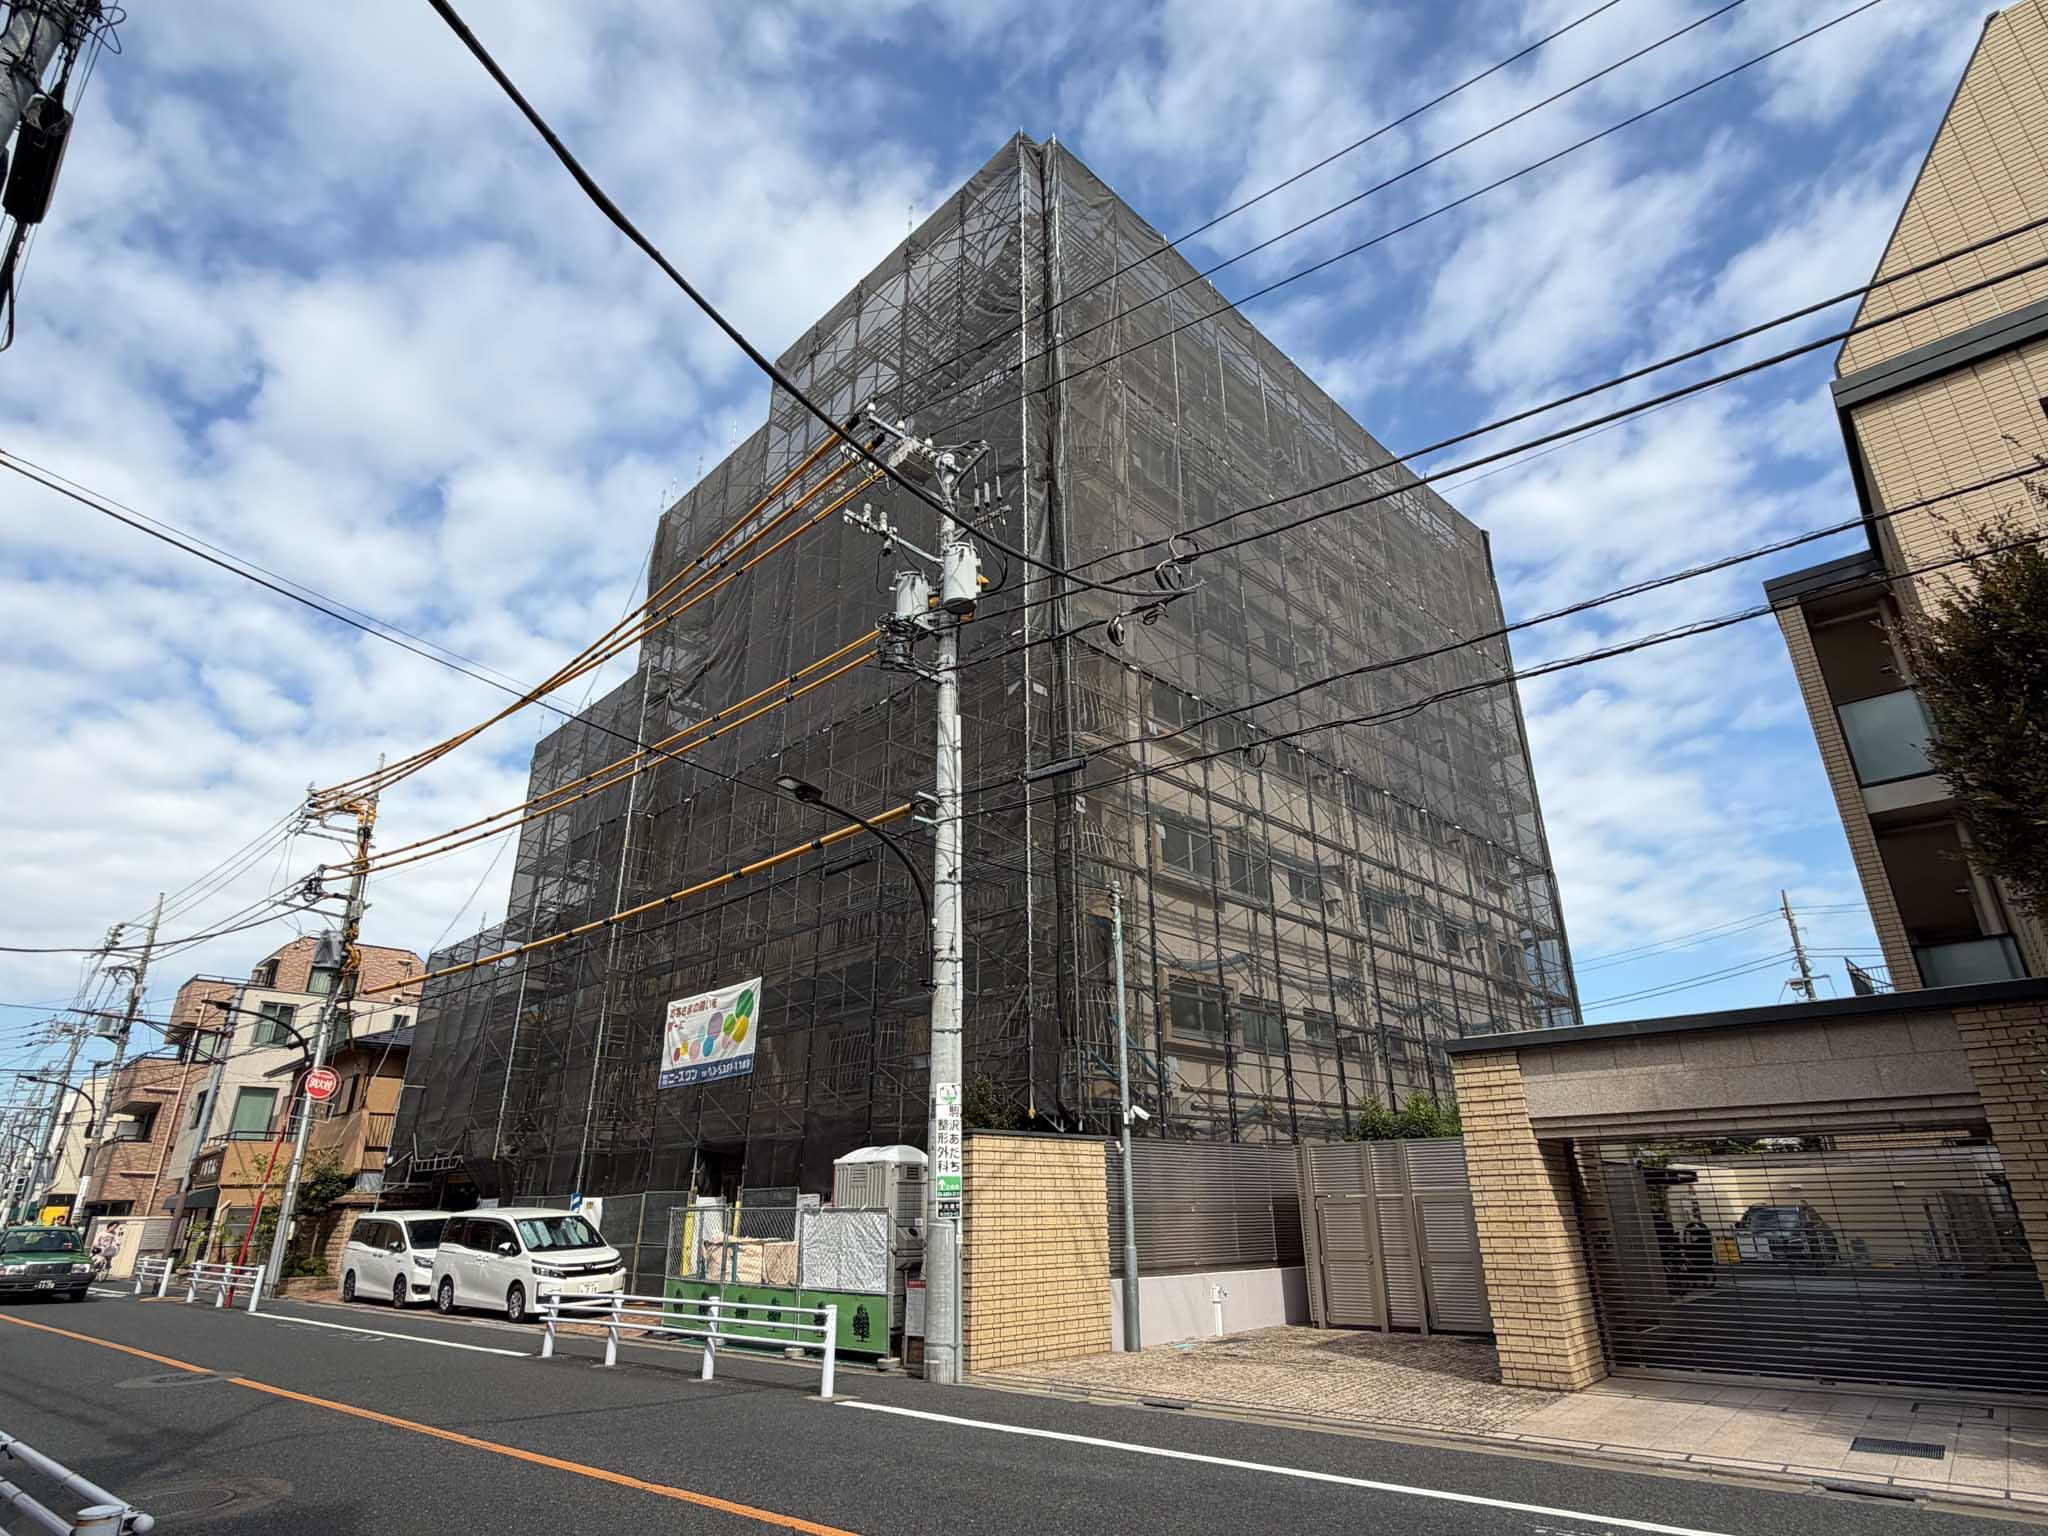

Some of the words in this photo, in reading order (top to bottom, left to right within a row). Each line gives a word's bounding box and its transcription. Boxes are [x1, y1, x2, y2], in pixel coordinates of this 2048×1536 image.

[937, 1118, 950, 1173] 整形外科
[949, 1105, 961, 1173] 駒沢あだち
